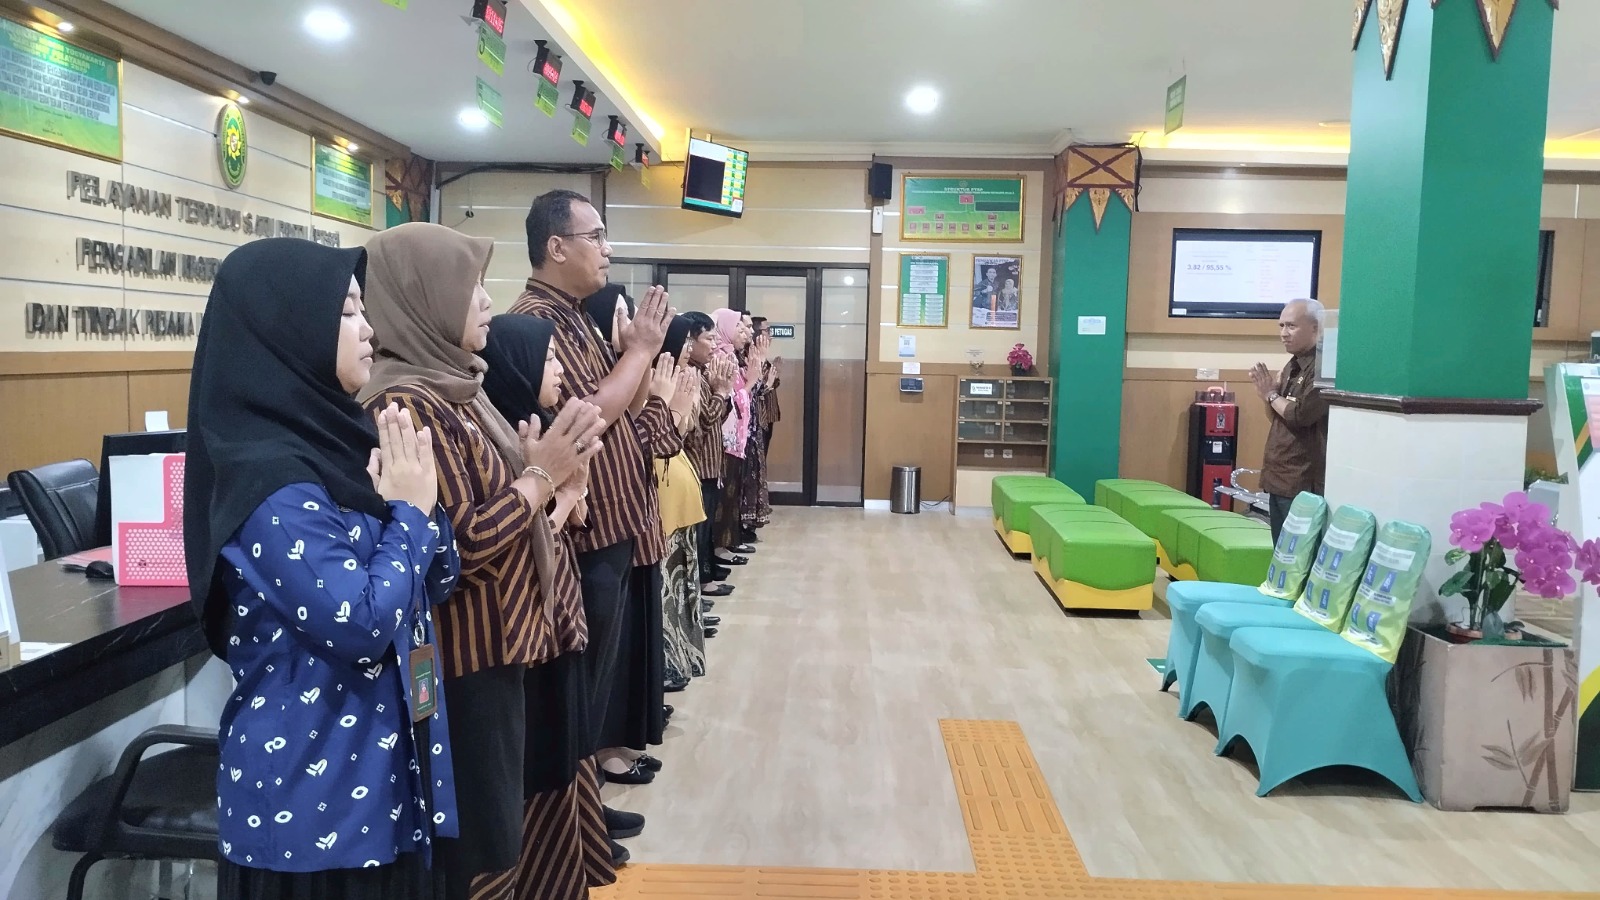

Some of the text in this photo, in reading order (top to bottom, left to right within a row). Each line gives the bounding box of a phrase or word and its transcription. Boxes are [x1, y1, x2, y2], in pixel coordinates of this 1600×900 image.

[66, 170, 172, 219] PELAYANAN
[76, 237, 176, 278] PENGADILAN
[25, 302, 69, 333] DAN
[72, 306, 140, 336] TINDAK
[774, 327, 793, 336] PETUGAS
